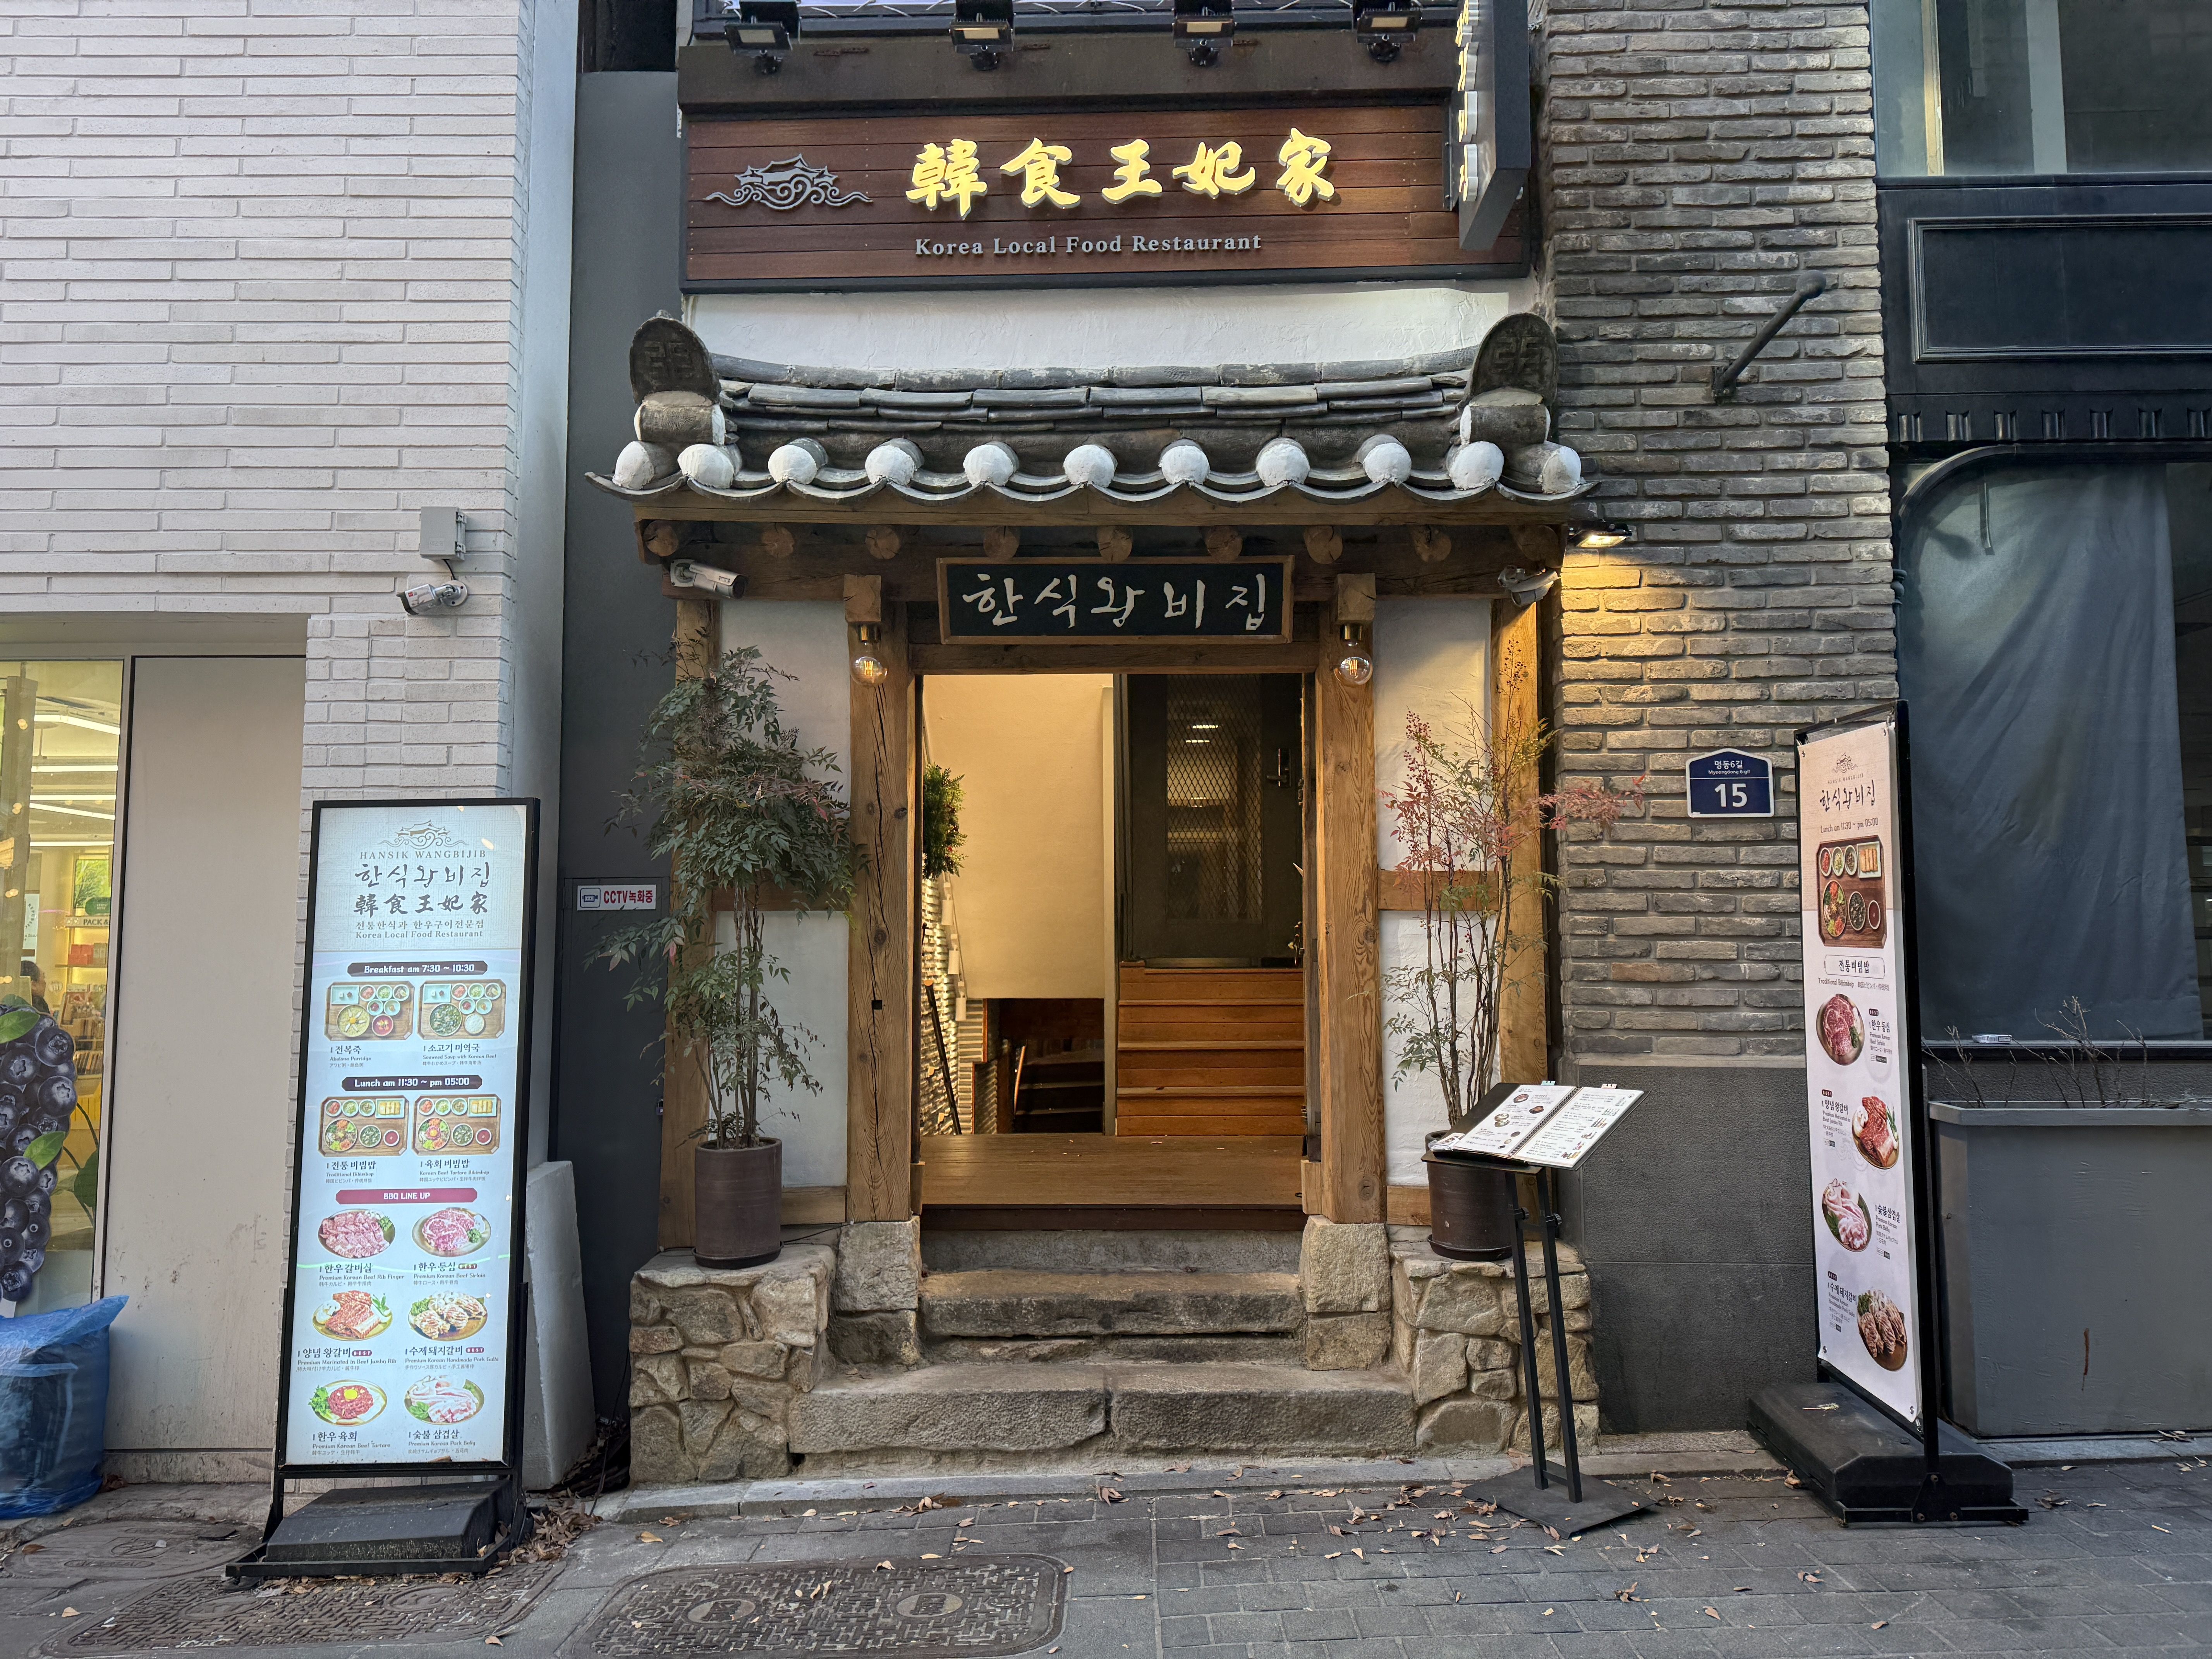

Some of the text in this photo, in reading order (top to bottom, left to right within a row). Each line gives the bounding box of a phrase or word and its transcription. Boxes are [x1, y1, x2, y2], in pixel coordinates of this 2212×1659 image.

[905, 127, 1335, 219] 韓食王妃家
[915, 234, 1262, 257] Korea Local Food Restaurant
[962, 573, 1266, 630] 한식왕비집
[1714, 760, 1743, 769] 명동6길
[1714, 783, 1747, 807] 15
[1820, 780, 1875, 812] 한식왕비집
[1821, 824, 1833, 833] Lunch
[360, 850, 487, 859] HANSIK WANGBIJIB
[355, 862, 489, 888] 한식왕비집
[603, 890, 653, 903] CCTV녹화중
[354, 891, 488, 918] 韓食王妃家
[356, 921, 408, 930] 전통한식과
[453, 964, 474, 972] 10:30
[1839, 959, 1870, 973] 전통비빔밥
[335, 1045, 361, 1054] 전복죽
[428, 1043, 479, 1053] 소고기 미역국
[331, 1161, 376, 1170] 전통 비빔밥
[425, 1159, 470, 1169] 육회 비빔밥
[325, 1264, 343, 1273] 한우
[418, 1262, 436, 1272] 한우
[438, 1262, 455, 1271] 등심
[303, 1348, 321, 1358] 양념
[323, 1348, 350, 1358] 왕갈비
[409, 1346, 427, 1356] 수제
[428, 1346, 462, 1355] 돼지갈비
[318, 1431, 357, 1442] 한우 육회
[413, 1429, 460, 1440] 숯불 삼겹살
